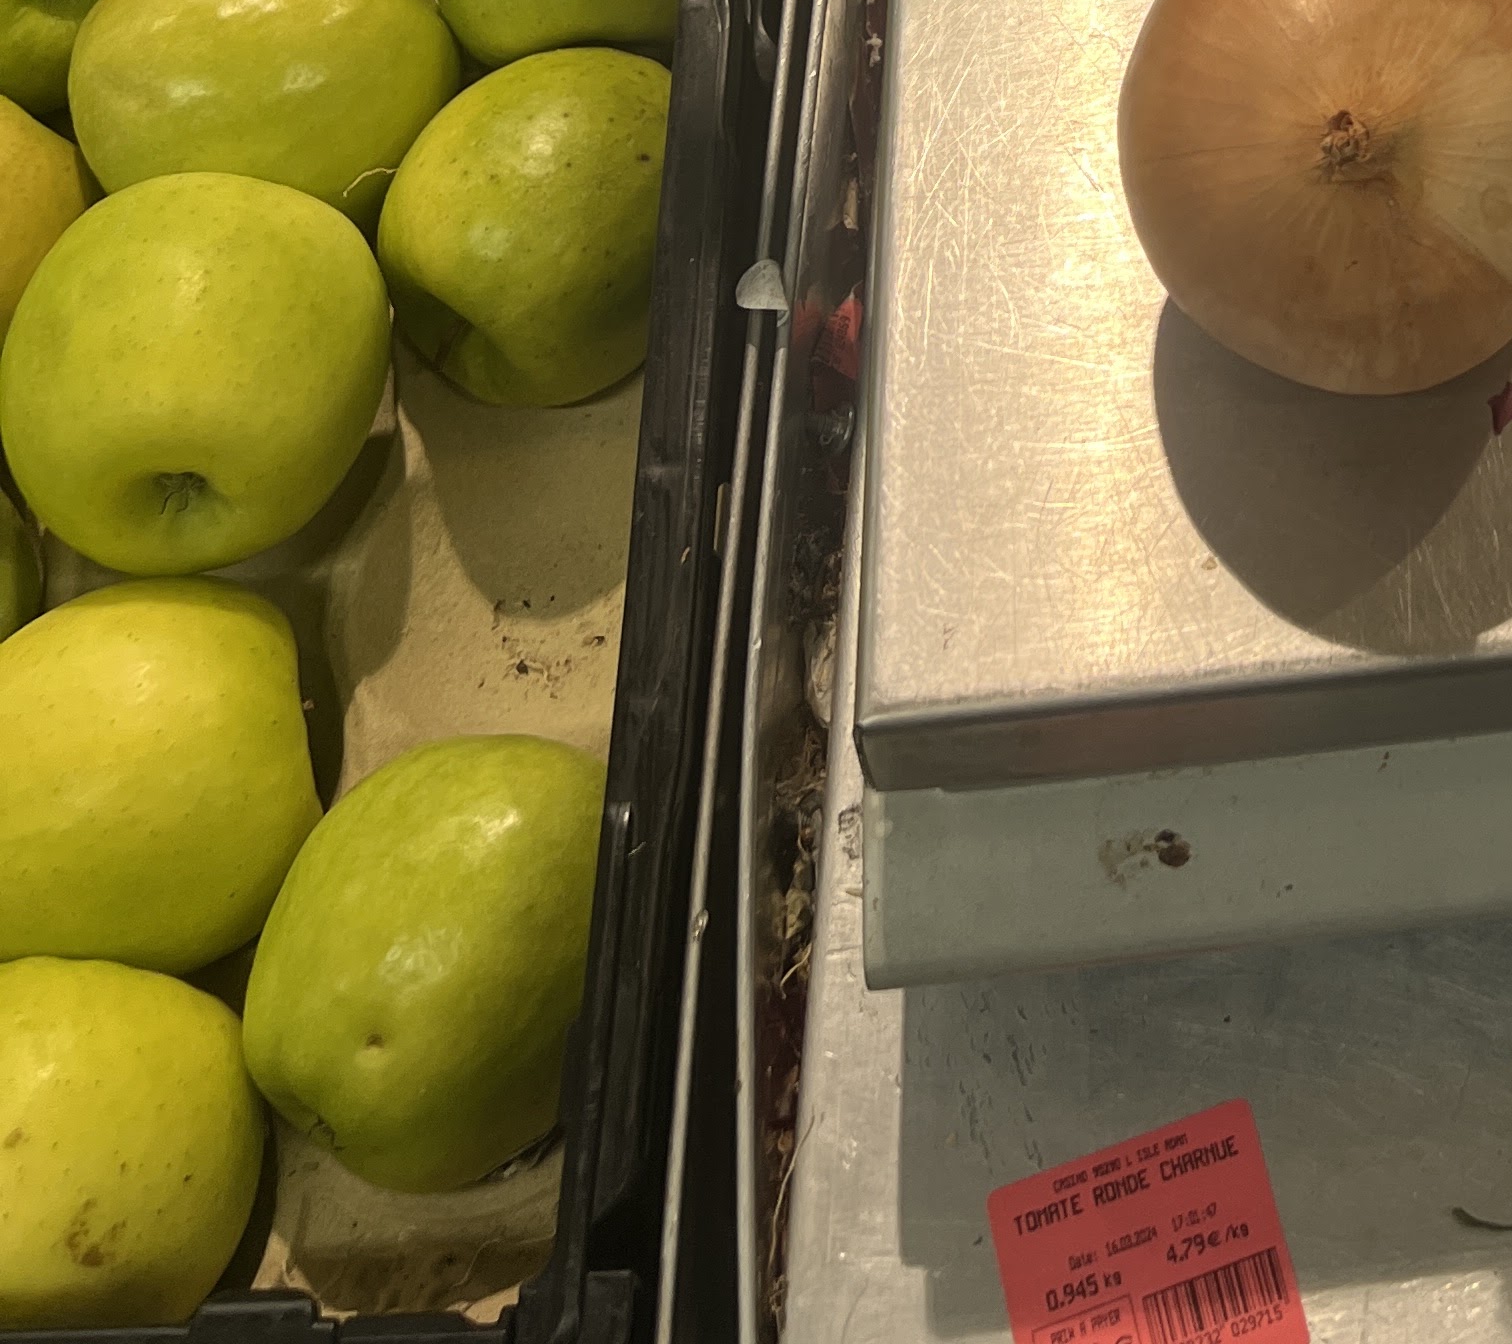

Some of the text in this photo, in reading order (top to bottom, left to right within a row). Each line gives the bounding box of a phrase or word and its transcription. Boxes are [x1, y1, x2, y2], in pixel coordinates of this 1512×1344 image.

[1013, 1193, 1083, 1235] TOMATE
[1093, 1168, 1151, 1207] RONDE
[1160, 1135, 1240, 1182] CHARNUE
[1045, 1273, 1099, 1311] 0.945
